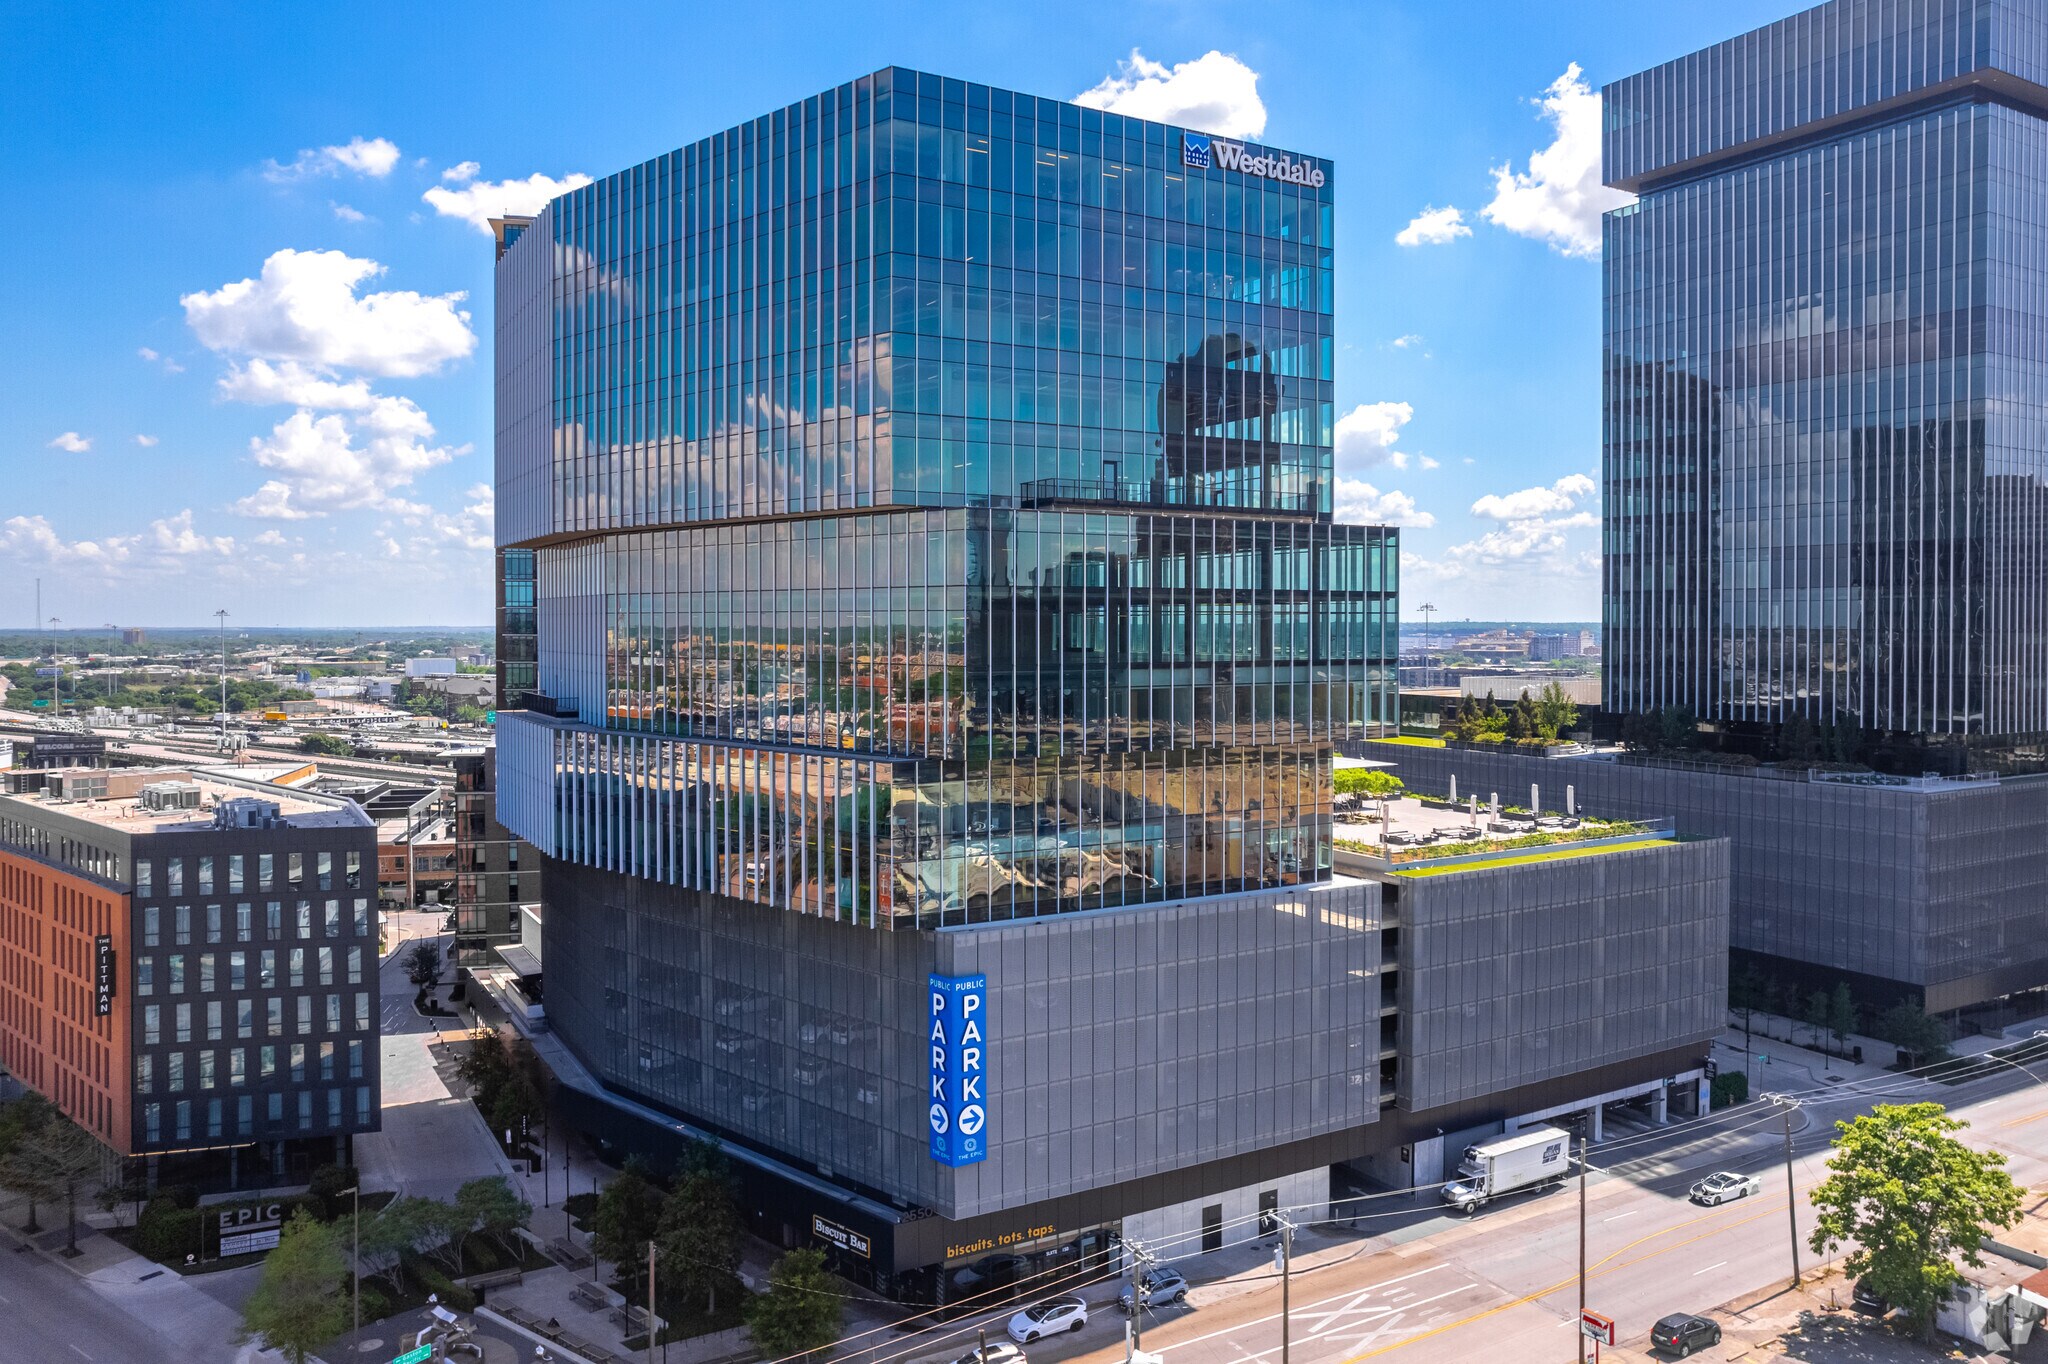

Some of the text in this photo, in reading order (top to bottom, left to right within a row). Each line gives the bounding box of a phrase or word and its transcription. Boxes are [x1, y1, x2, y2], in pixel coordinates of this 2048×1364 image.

[1212, 140, 1325, 188] Westdale
[100, 946, 109, 1013] PITTMAN
[930, 978, 951, 991] PUBLIC
[955, 979, 984, 991] PUBLIC
[931, 992, 947, 1102] PARK
[961, 994, 982, 1102] PARK
[958, 1152, 969, 1160] THE
[220, 1204, 280, 1226] EPIC
[902, 1207, 933, 1223] 2550
[815, 1219, 867, 1252] BISCUIT BAR
[947, 1224, 1056, 1258] biscuits. tots. taps.
